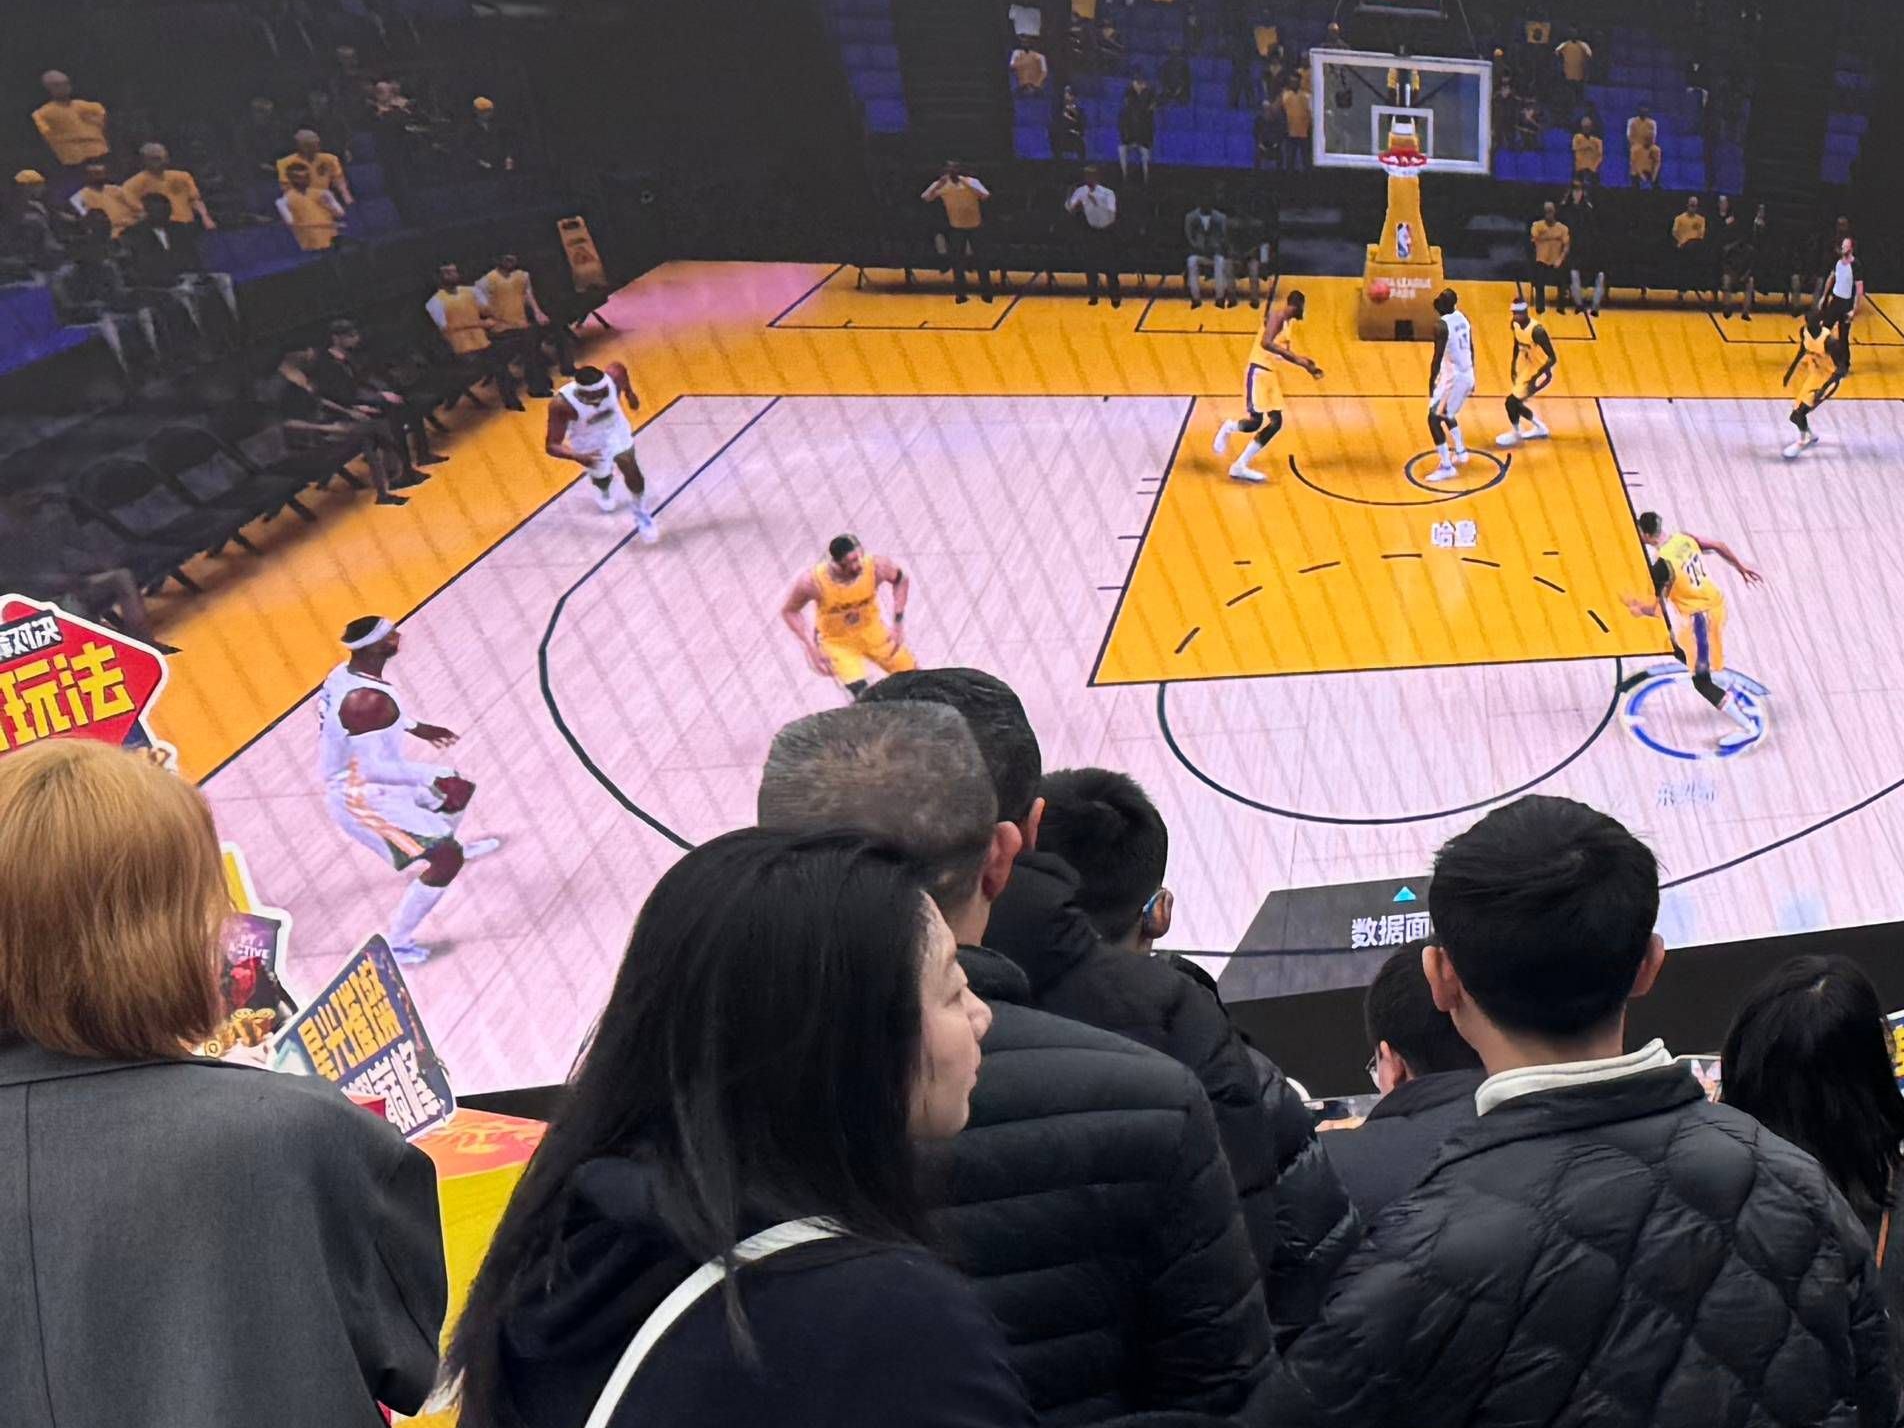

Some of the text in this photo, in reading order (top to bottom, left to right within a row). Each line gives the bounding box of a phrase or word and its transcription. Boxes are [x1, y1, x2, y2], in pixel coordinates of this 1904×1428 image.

[0, 641, 136, 751] 玩法
[1351, 911, 1435, 950] 数据面
